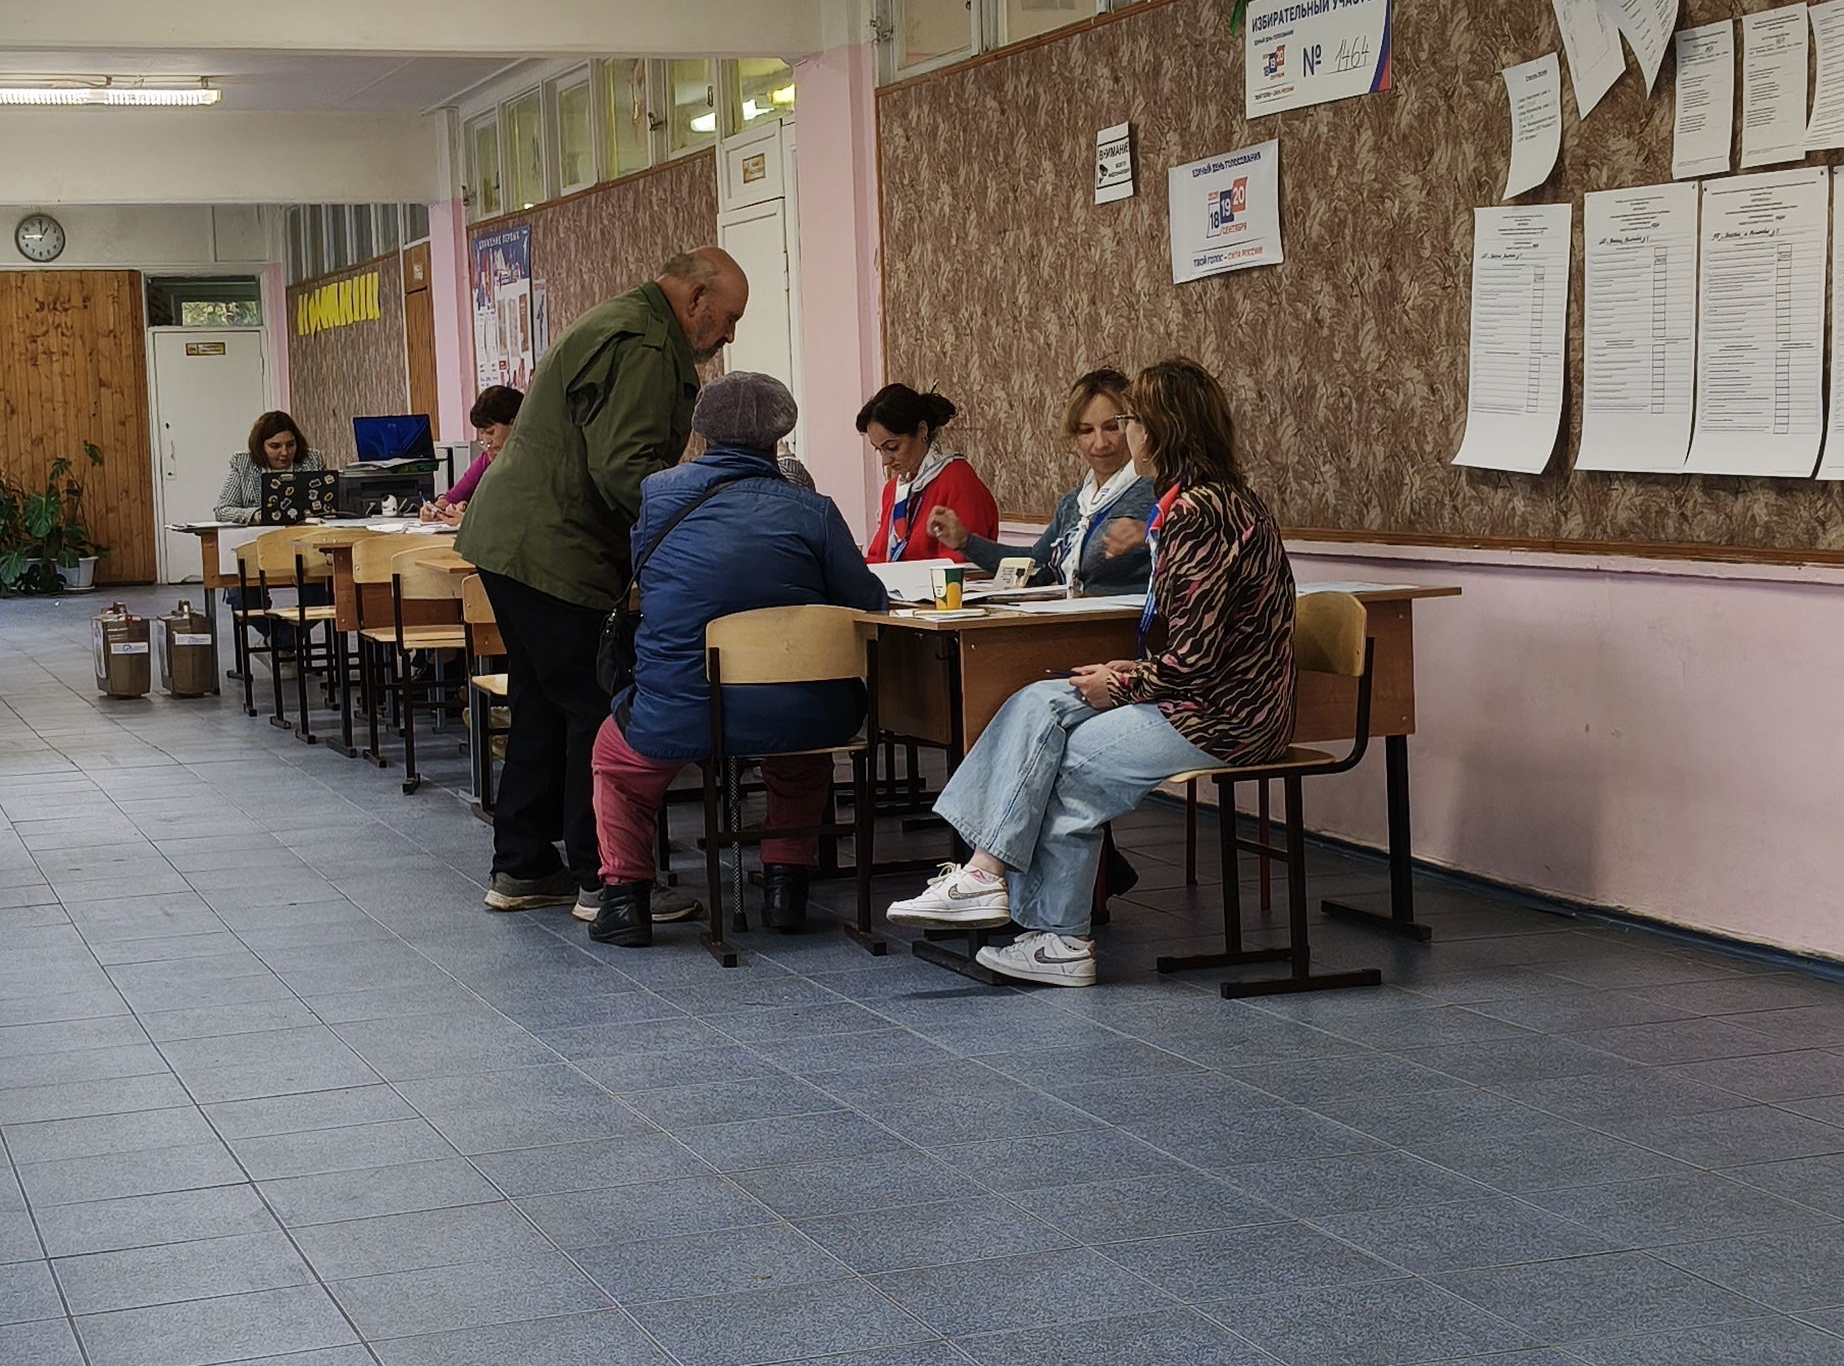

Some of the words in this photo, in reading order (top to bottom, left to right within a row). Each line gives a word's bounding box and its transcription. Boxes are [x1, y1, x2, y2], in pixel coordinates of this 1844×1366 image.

[1303, 44, 1322, 77] №
[1335, 35, 1370, 72] 1464
[1232, 186, 1245, 205] 20
[1221, 198, 1231, 217] 19
[1210, 211, 1220, 230] 18
